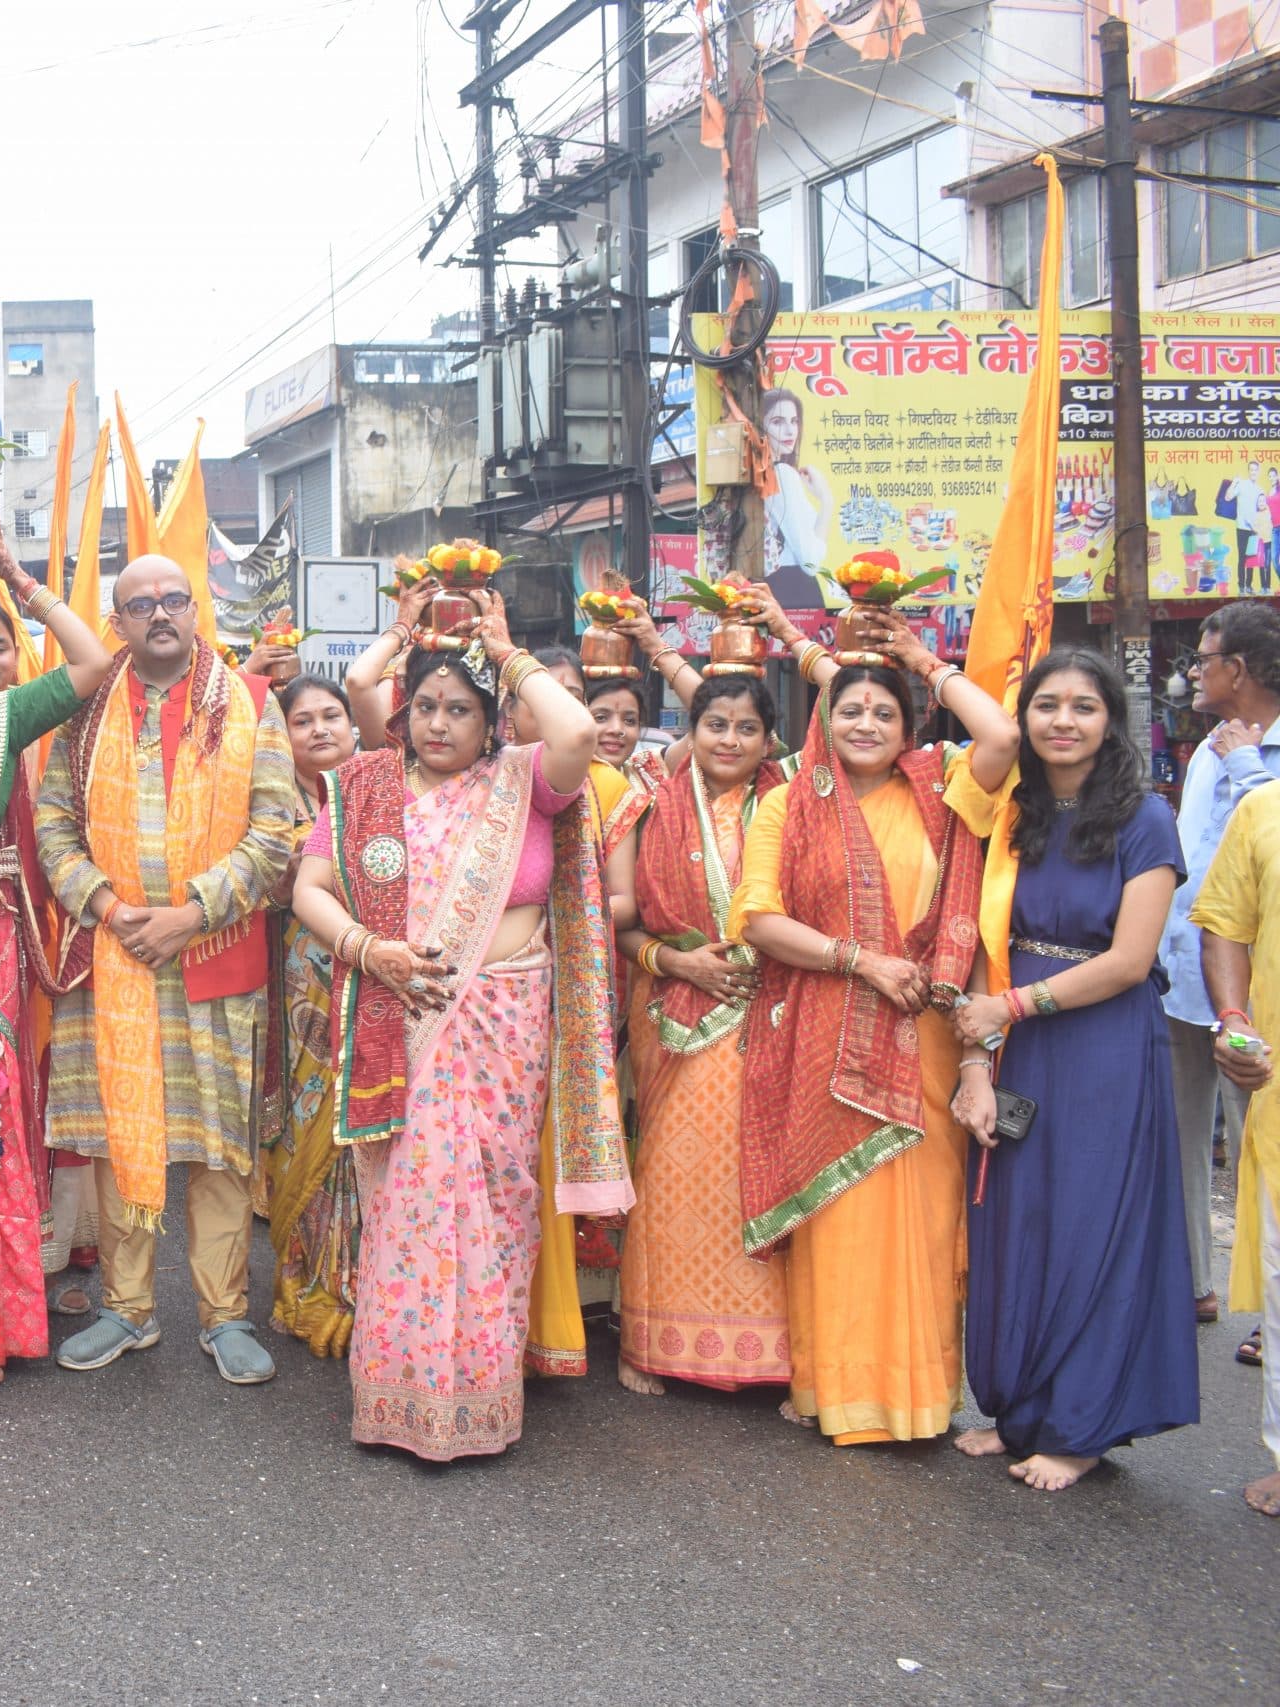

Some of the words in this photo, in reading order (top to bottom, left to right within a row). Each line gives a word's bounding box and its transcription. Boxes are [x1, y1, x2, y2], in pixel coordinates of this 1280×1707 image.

[1192, 314, 1220, 327] सेल
[1248, 315, 1276, 328] सेल
[766, 340, 848, 396] न्यू
[849, 326, 972, 377] बॉम्बे
[1171, 341, 1280, 376] बाजा
[832, 409, 861, 427] किचन
[864, 409, 889, 427] वियर
[1060, 403, 1114, 425] बिग
[1165, 449, 1199, 464] अलग
[327, 640, 356, 656] सबसे
